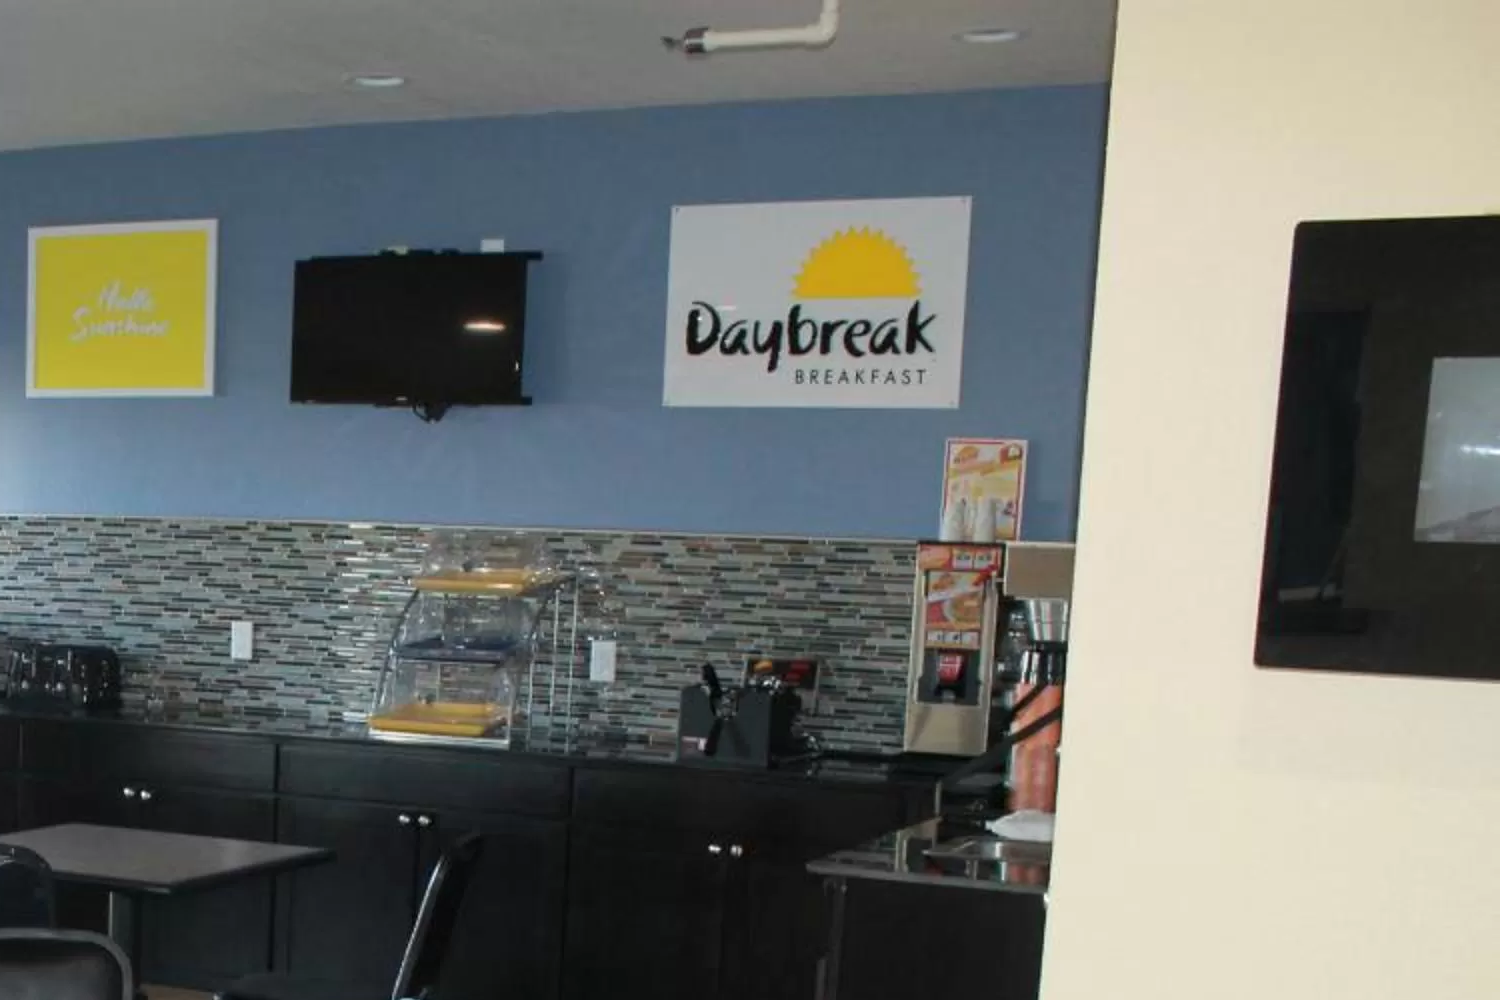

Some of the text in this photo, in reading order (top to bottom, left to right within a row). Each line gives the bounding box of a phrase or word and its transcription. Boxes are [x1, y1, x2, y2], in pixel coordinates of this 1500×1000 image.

[68, 305, 171, 343] Sunshine
[685, 300, 937, 374] Daybreak
[795, 368, 927, 385] BREAKFAST
